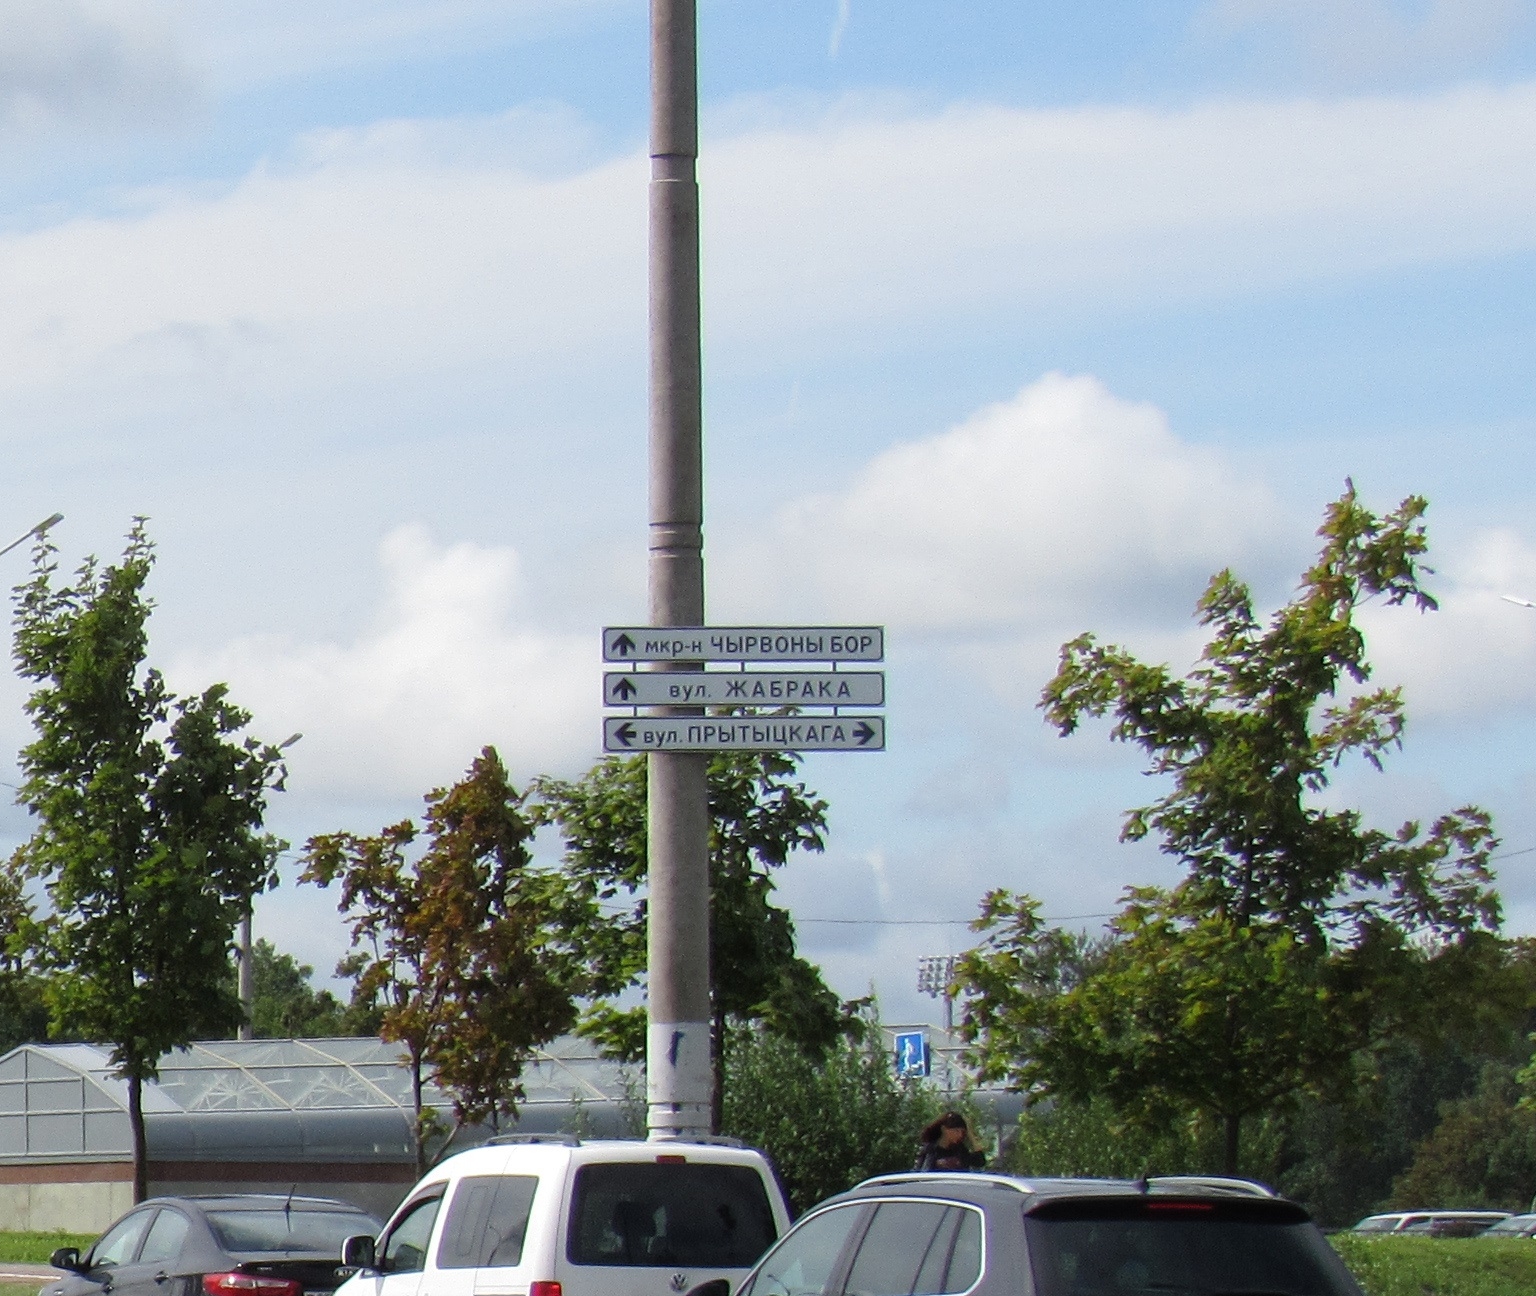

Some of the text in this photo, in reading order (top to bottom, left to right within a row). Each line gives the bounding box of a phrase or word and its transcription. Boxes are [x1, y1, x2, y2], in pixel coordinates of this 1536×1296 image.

[645, 636, 872, 657] мкр-н ЧЫРВОНЫ БОР
[669, 680, 851, 701] вул. ЖАБРАКА
[643, 725, 846, 748] вул. ПРЫТЫЦКАГА
